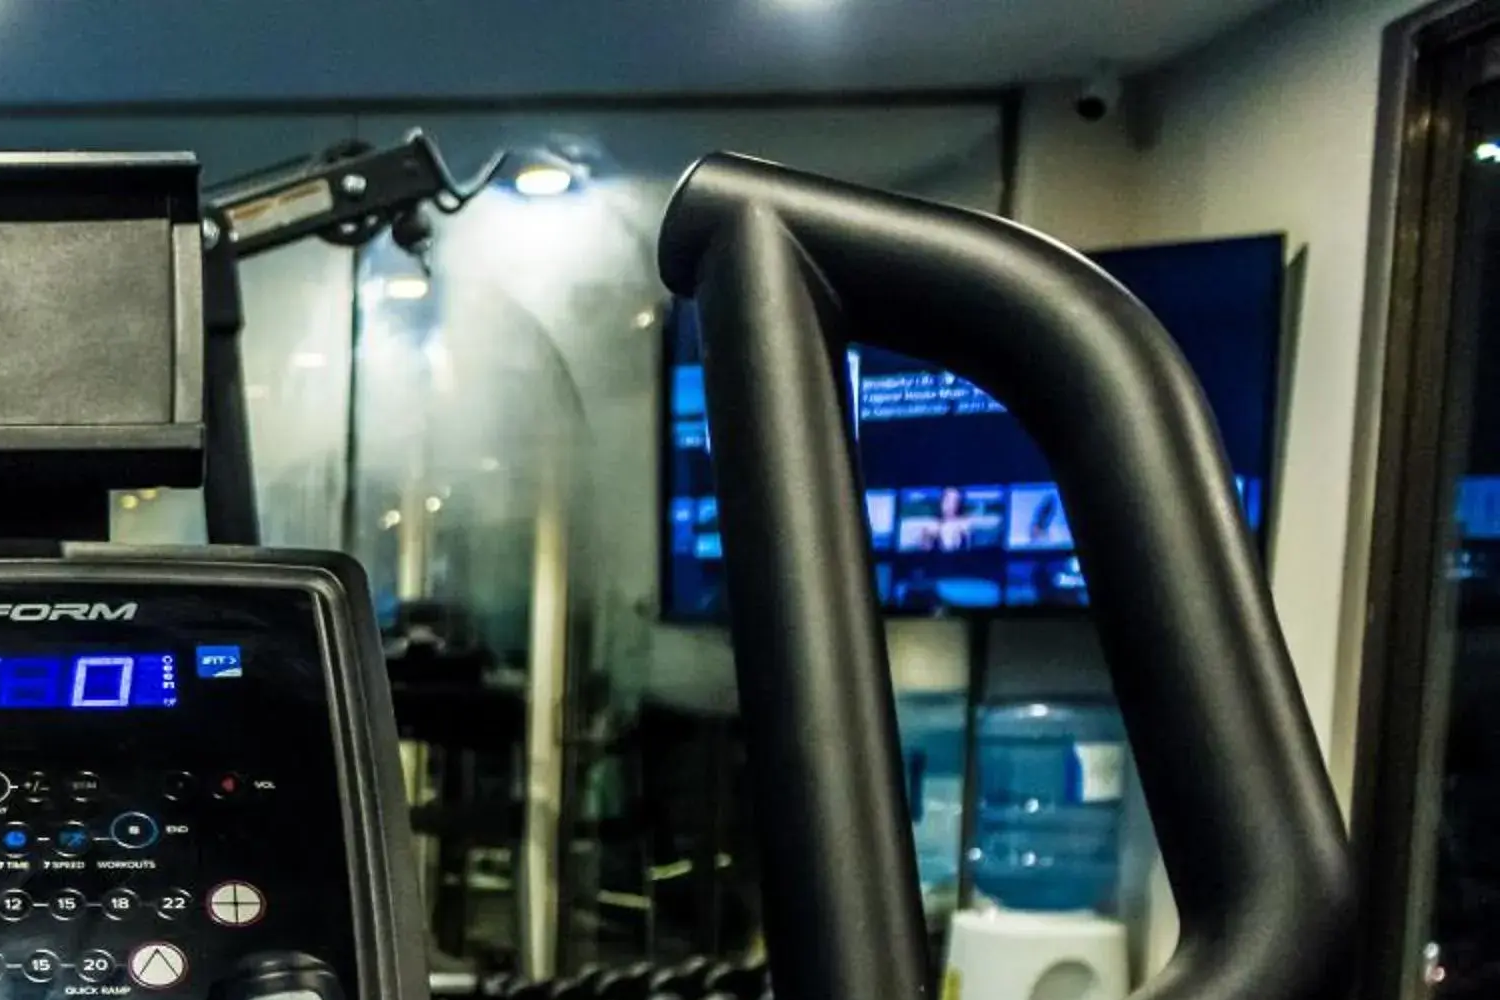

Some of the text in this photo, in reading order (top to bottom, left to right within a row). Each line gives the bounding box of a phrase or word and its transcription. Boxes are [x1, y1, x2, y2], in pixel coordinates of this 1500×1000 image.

[254, 780, 276, 789] VOL
[165, 824, 189, 833] END
[6, 861, 30, 870] TIME
[51, 861, 85, 870] SPEED
[97, 861, 156, 869] WORKOUTS
[4, 898, 22, 910] 12
[56, 898, 76, 910] 15
[110, 898, 130, 910] 18
[162, 897, 186, 909] 22
[31, 960, 50, 971] 15
[83, 959, 109, 971] 20
[64, 986, 131, 995] QUICK RAMP
